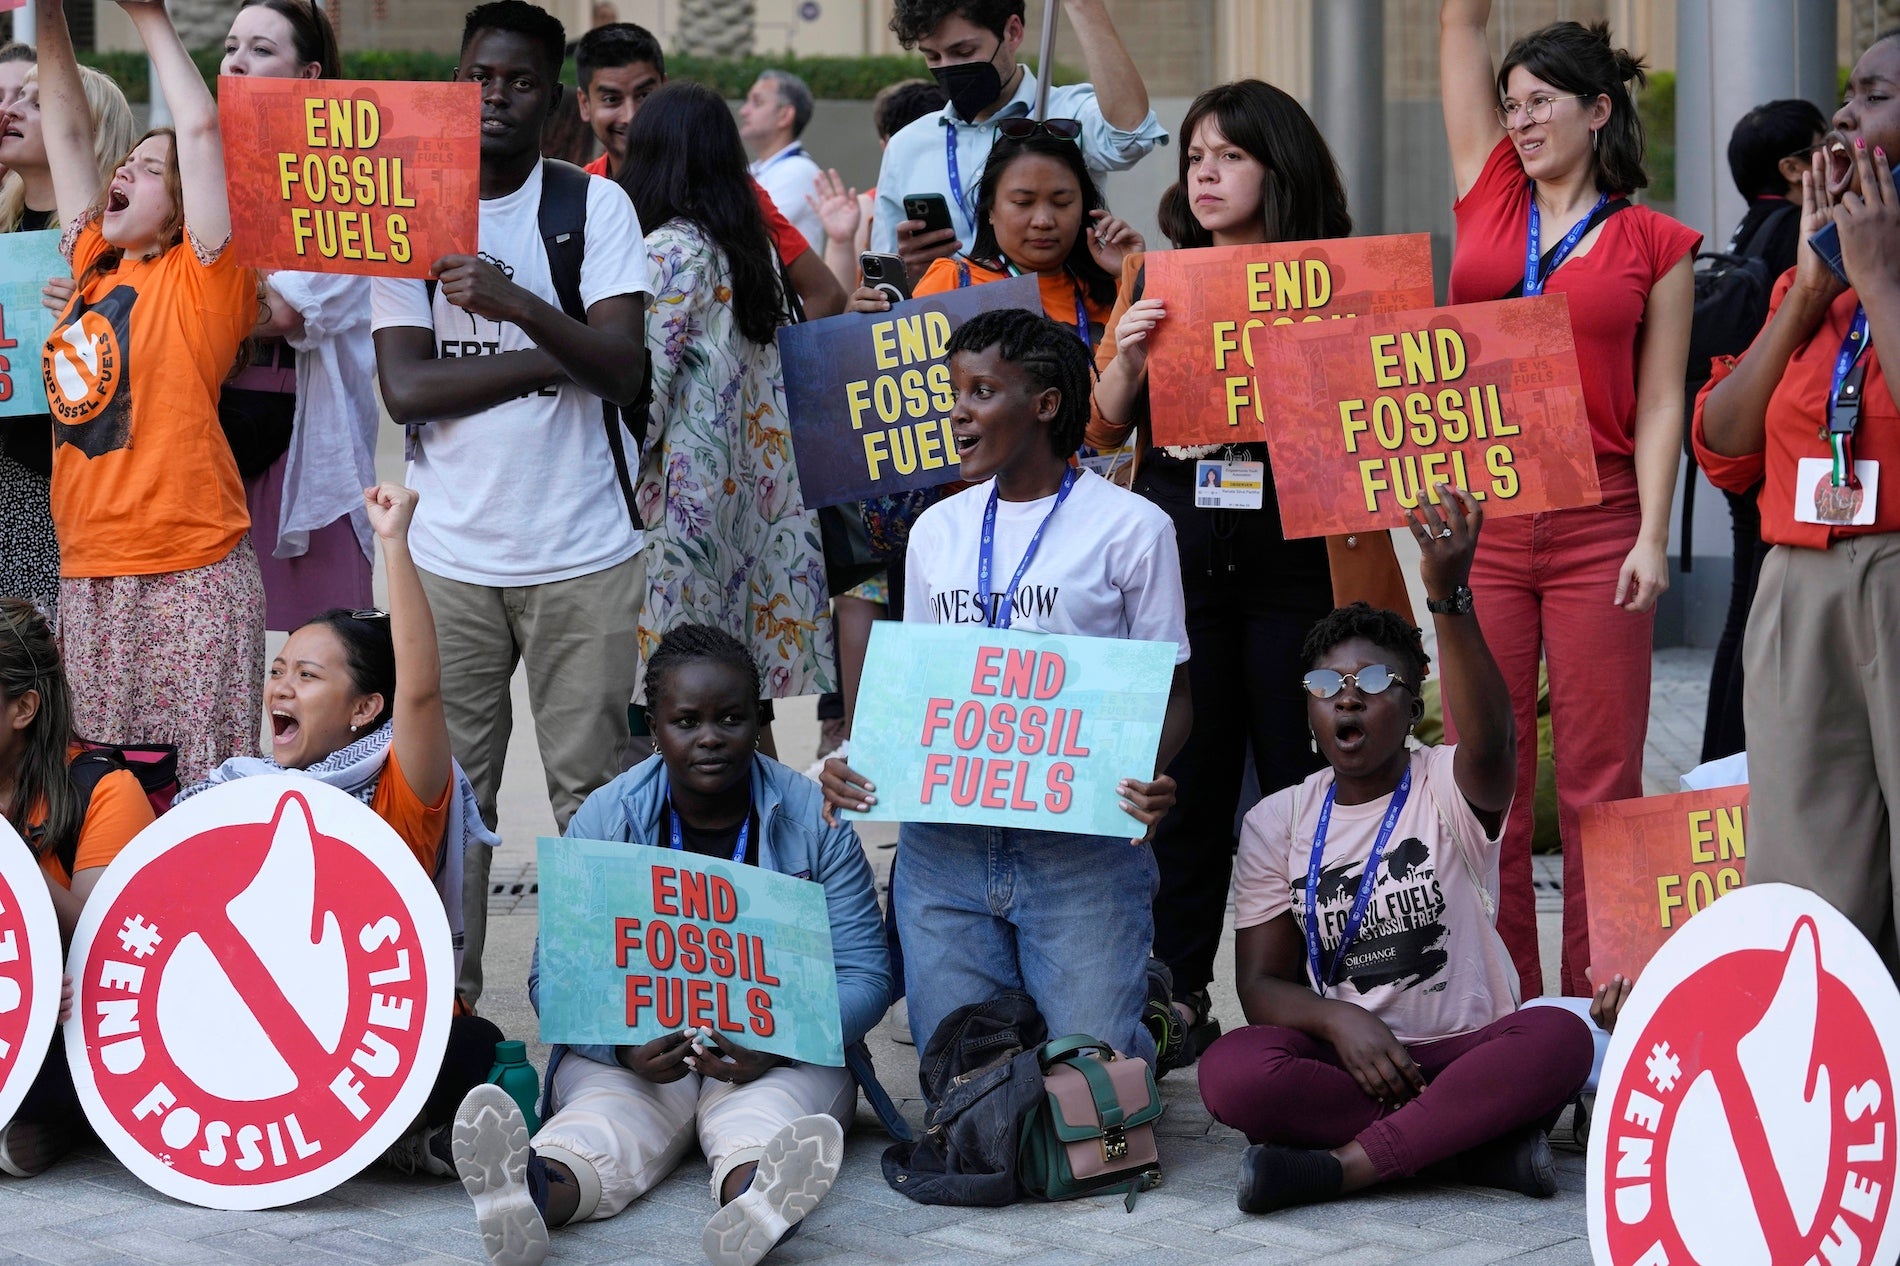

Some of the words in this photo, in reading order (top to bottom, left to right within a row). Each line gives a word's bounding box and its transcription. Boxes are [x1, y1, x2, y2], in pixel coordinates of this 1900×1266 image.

[305, 98, 381, 149] END
[278, 153, 416, 208] FOSSIL
[292, 208, 413, 263] FUELS
[1247, 259, 1331, 312] END
[96, 332, 113, 396] FUELS
[872, 311, 951, 370] END
[1370, 328, 1466, 389] END
[53, 395, 100, 418] FOSSIL
[846, 364, 956, 430] FOSS
[1338, 384, 1521, 453] FOSSIL
[863, 418, 962, 481] FUEL
[1358, 444, 1519, 512] FUELS
[971, 645, 1065, 699] END
[921, 698, 1090, 757] FOSSIL
[920, 754, 1074, 814] FUELS
[1688, 804, 1749, 864] EN
[651, 865, 738, 923] END
[1372, 917, 1410, 939] FOSSIL
[1411, 907, 1438, 930] FREE
[1385, 879, 1444, 921] FUELS
[614, 917, 781, 987] FOSSIL
[329, 915, 413, 1121] FUELS
[625, 974, 774, 1038] FUELS
[132, 1081, 322, 1171] FOSSIL
[1803, 1079, 1885, 1266] UELS
